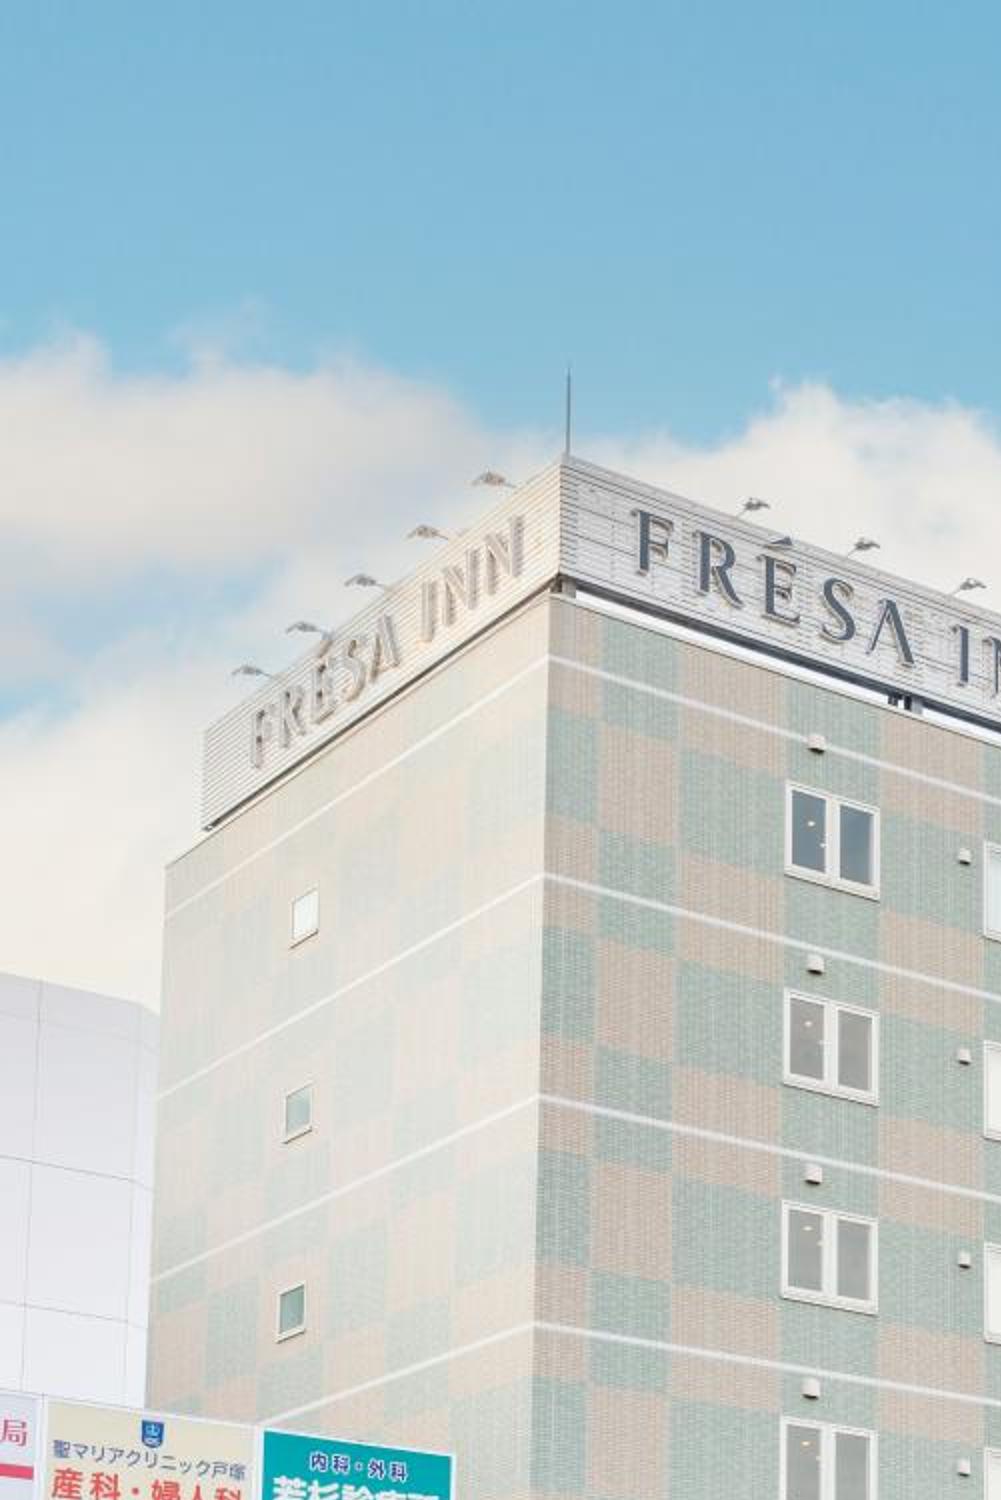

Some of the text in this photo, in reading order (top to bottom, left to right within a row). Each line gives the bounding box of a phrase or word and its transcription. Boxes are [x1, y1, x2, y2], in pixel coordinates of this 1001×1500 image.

[632, 508, 916, 668] FRÉSA
[251, 518, 525, 769] FRÉSA INN
[53, 1439, 246, 1481] 聖マリアクリニック戸塚
[310, 1451, 409, 1483] 内科・外科
